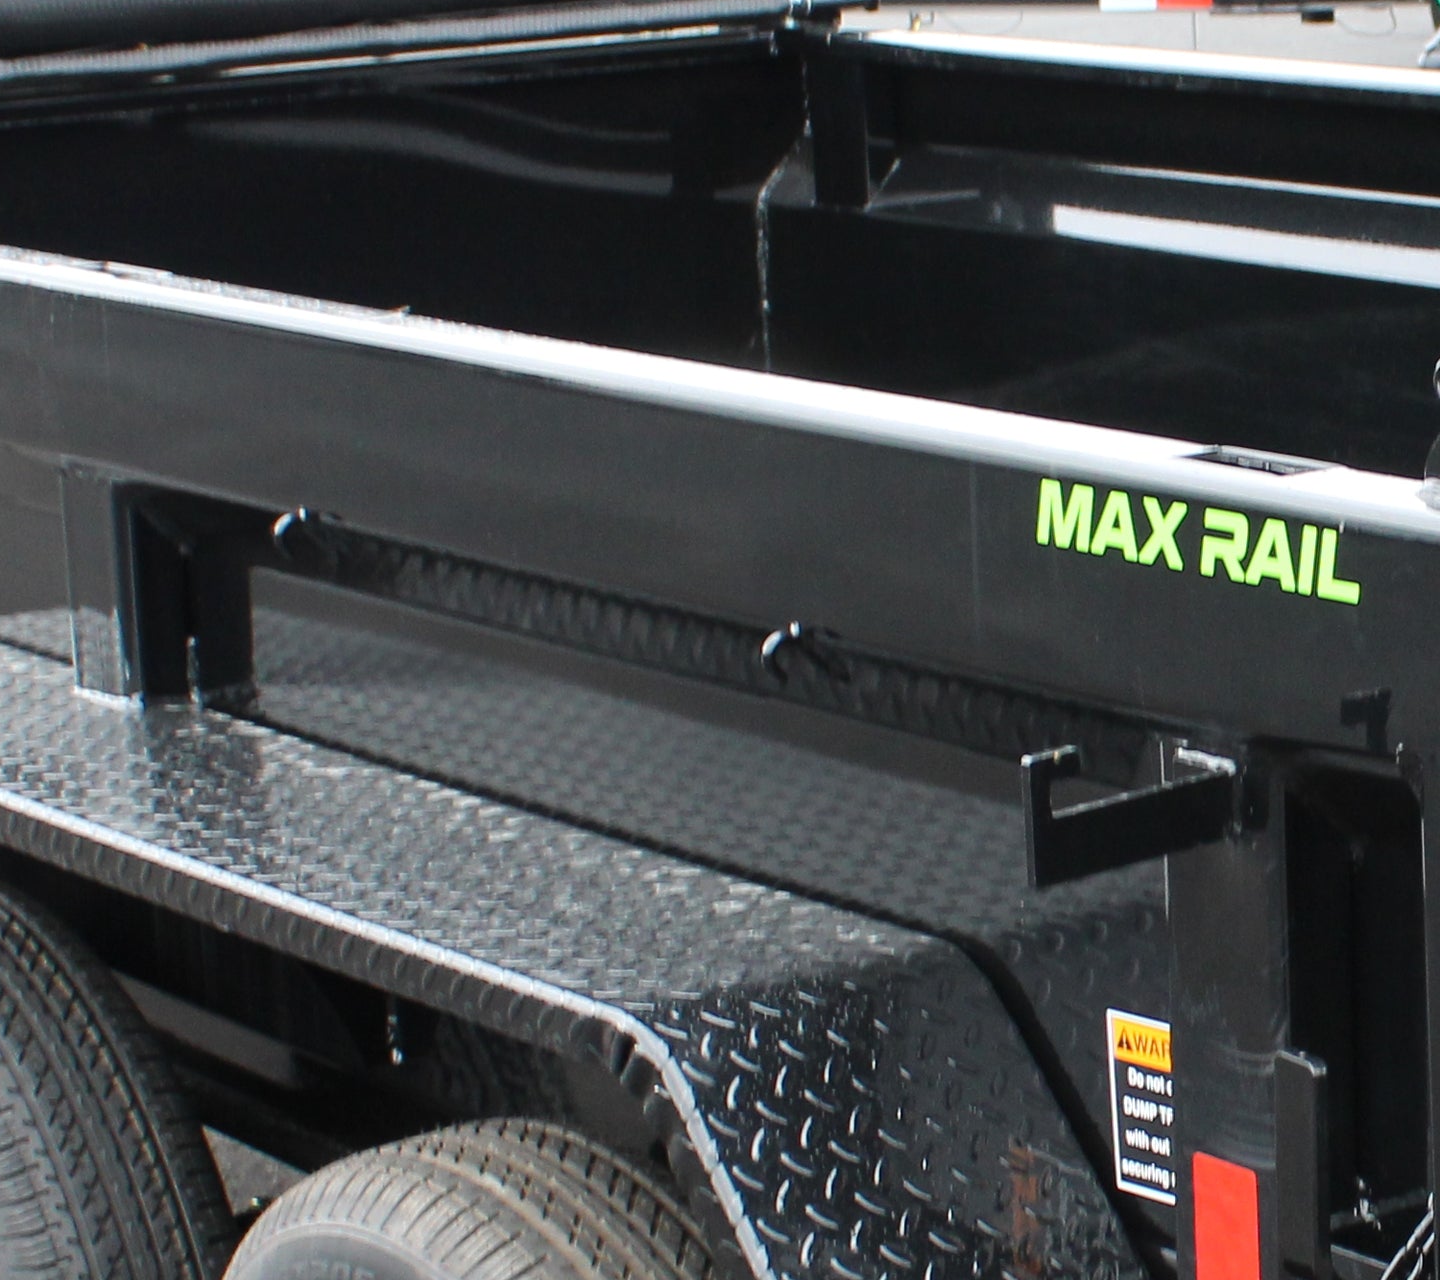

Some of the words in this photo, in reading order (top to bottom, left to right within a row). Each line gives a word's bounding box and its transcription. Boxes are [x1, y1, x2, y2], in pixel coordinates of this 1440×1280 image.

[1035, 477, 1188, 572] MAX
[1199, 506, 1361, 606] RAIL
[1127, 1066, 1145, 1089] Do
[1146, 1073, 1165, 1095] not
[1123, 1095, 1158, 1122] DUMP
[1125, 1128, 1150, 1151] with
[1151, 1136, 1170, 1157] out
[1122, 1158, 1170, 1190] securing
